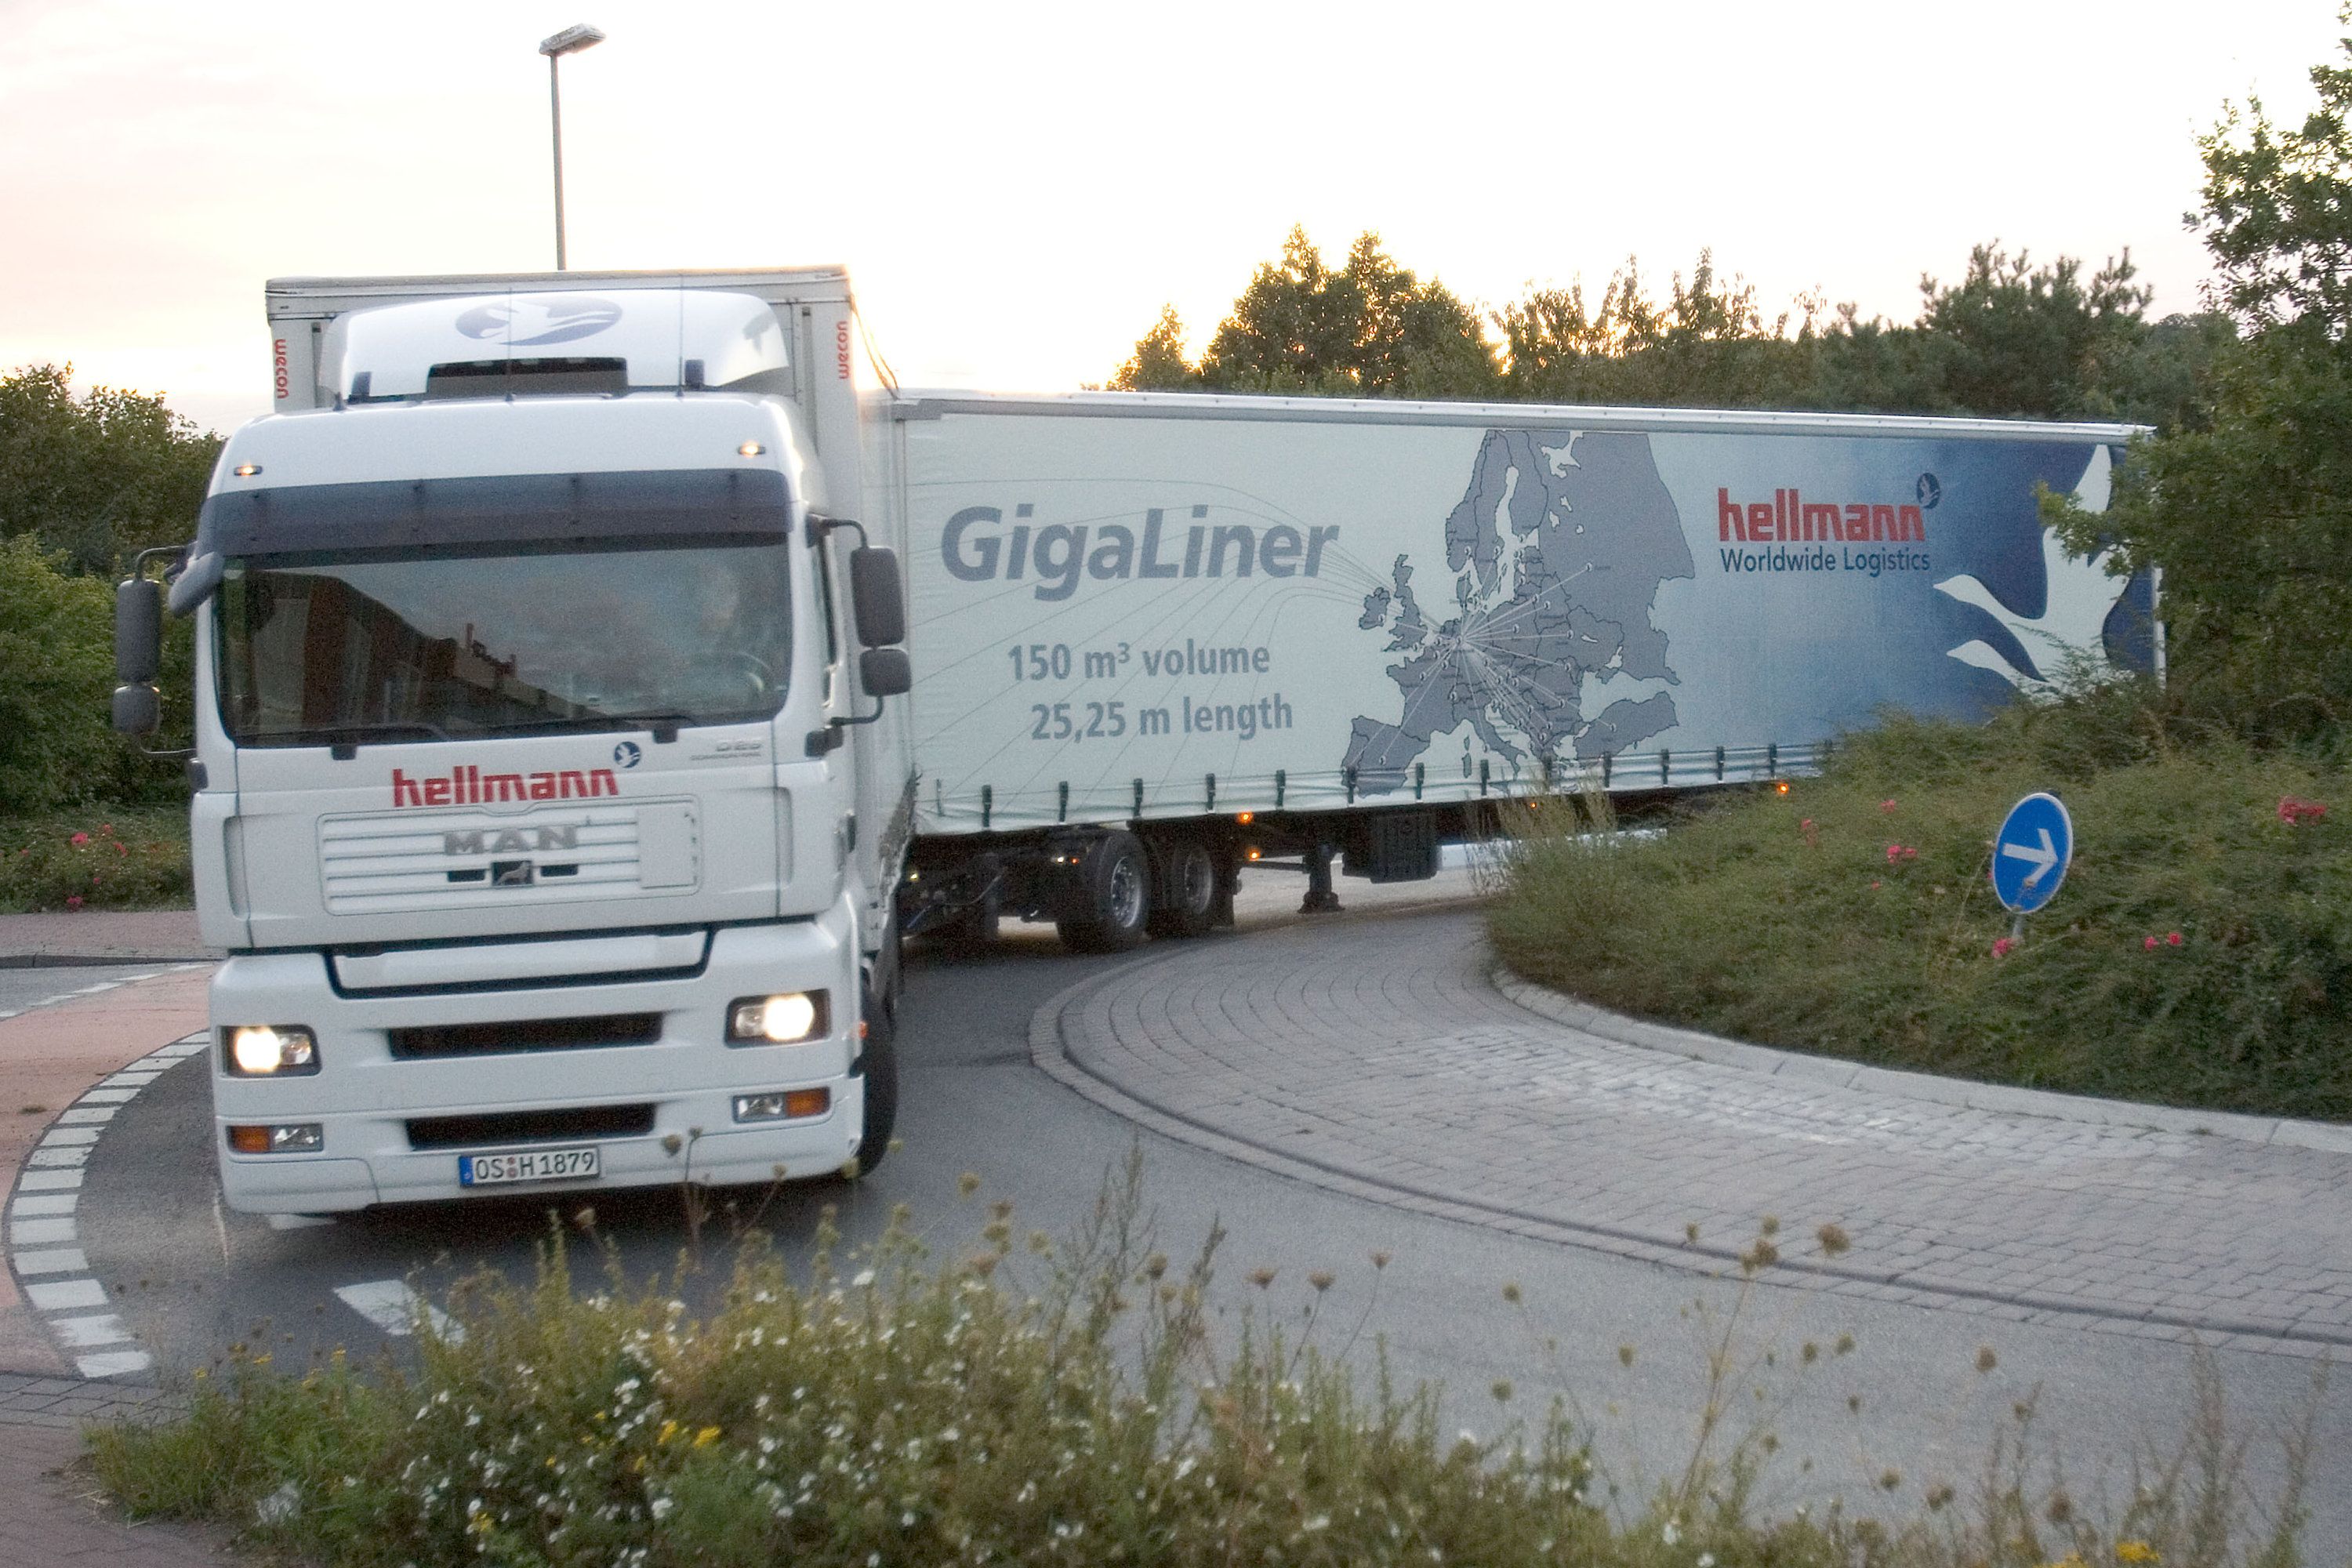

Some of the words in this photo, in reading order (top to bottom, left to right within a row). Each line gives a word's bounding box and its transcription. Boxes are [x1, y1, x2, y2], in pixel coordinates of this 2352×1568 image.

[274, 339, 289, 399] wecon
[837, 320, 849, 379] wecon
[1718, 487, 1926, 541] hellmann
[941, 503, 1340, 601] GigaLiner
[1720, 546, 1836, 572] Worldwide
[1844, 547, 1931, 577] Logistics
[1007, 644, 1071, 681] 150
[1142, 638, 1270, 676] volume
[1031, 702, 1126, 744] 25,25
[1139, 706, 1171, 735] m
[1183, 693, 1293, 740] length
[393, 765, 619, 808] hellmann
[443, 825, 578, 855] MAN
[475, 1158, 504, 1180] OS
